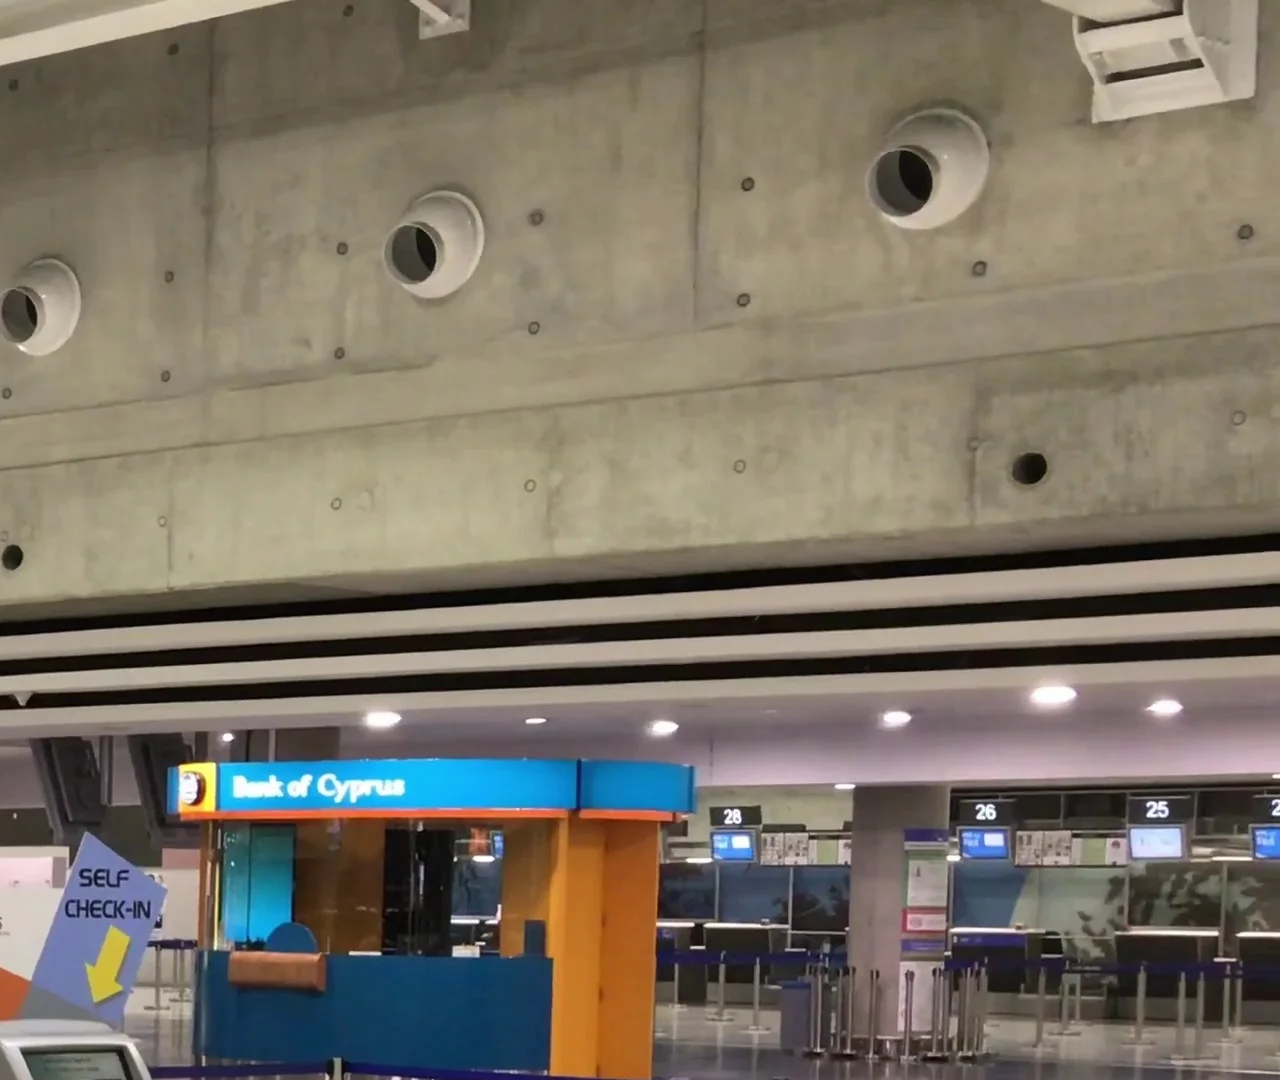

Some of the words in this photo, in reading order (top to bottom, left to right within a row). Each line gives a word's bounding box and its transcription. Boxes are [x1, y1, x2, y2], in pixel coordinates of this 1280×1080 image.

[233, 775, 283, 798] Bank
[287, 774, 313, 797] of
[317, 773, 405, 804] Cyprus
[723, 808, 742, 825] 28
[975, 804, 996, 820] 26
[1146, 801, 1169, 818] 25
[78, 868, 129, 888] SELF
[64, 899, 151, 920] CHECK-IN
